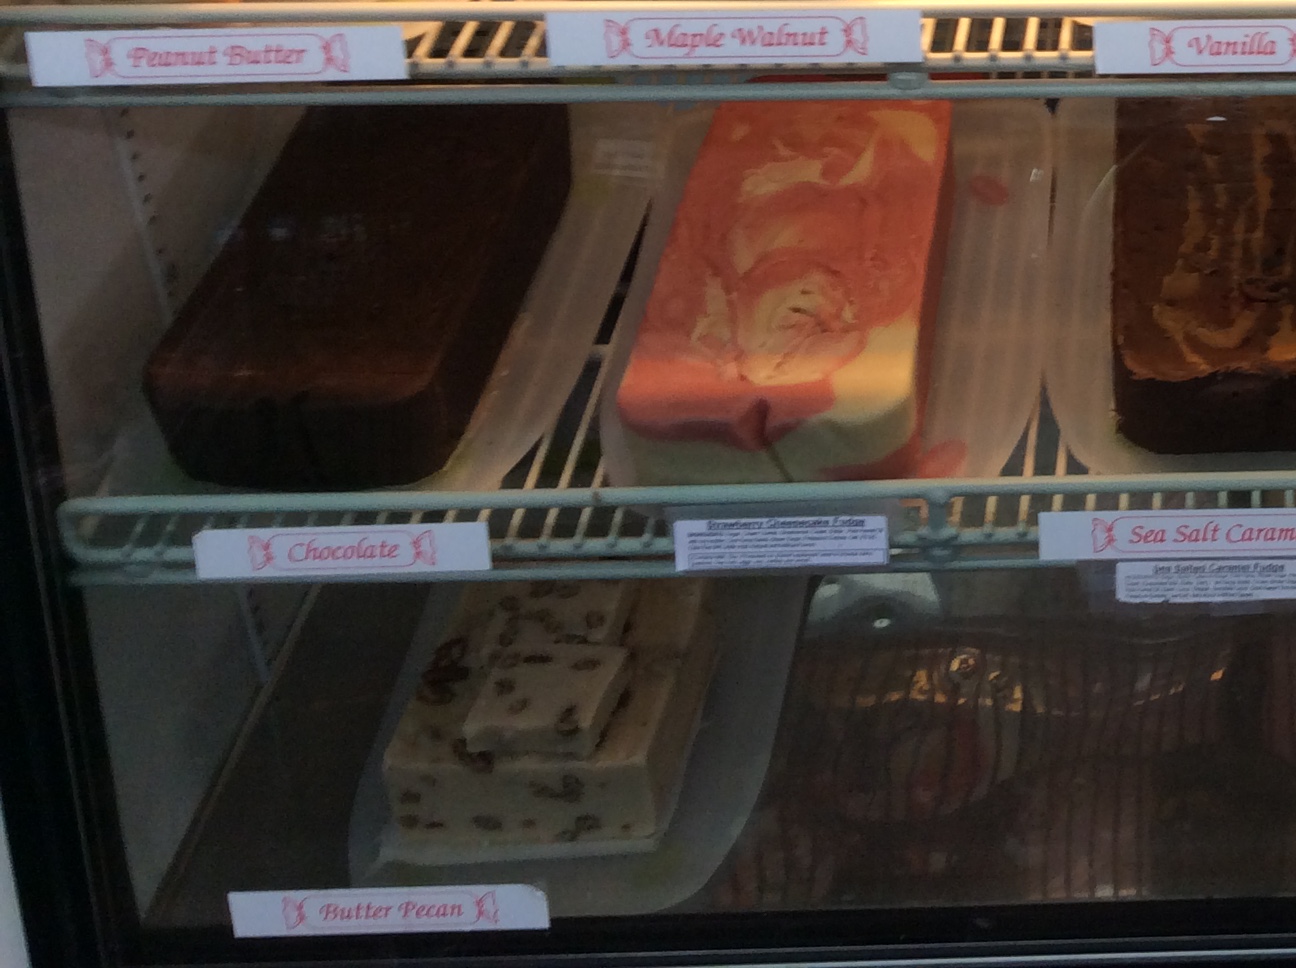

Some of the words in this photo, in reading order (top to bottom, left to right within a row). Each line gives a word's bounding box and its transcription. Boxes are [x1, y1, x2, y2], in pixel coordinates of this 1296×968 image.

[643, 22, 726, 58] Maple
[730, 22, 829, 48] Walnut
[1186, 31, 1277, 57] Vanilla
[126, 45, 218, 68] Peanut
[222, 43, 307, 66] Butter
[1128, 522, 1166, 545] Sea
[1173, 518, 1221, 544] Salt
[287, 536, 400, 563] Chocolate
[319, 901, 392, 922] Butter
[397, 899, 465, 919] Pecan
